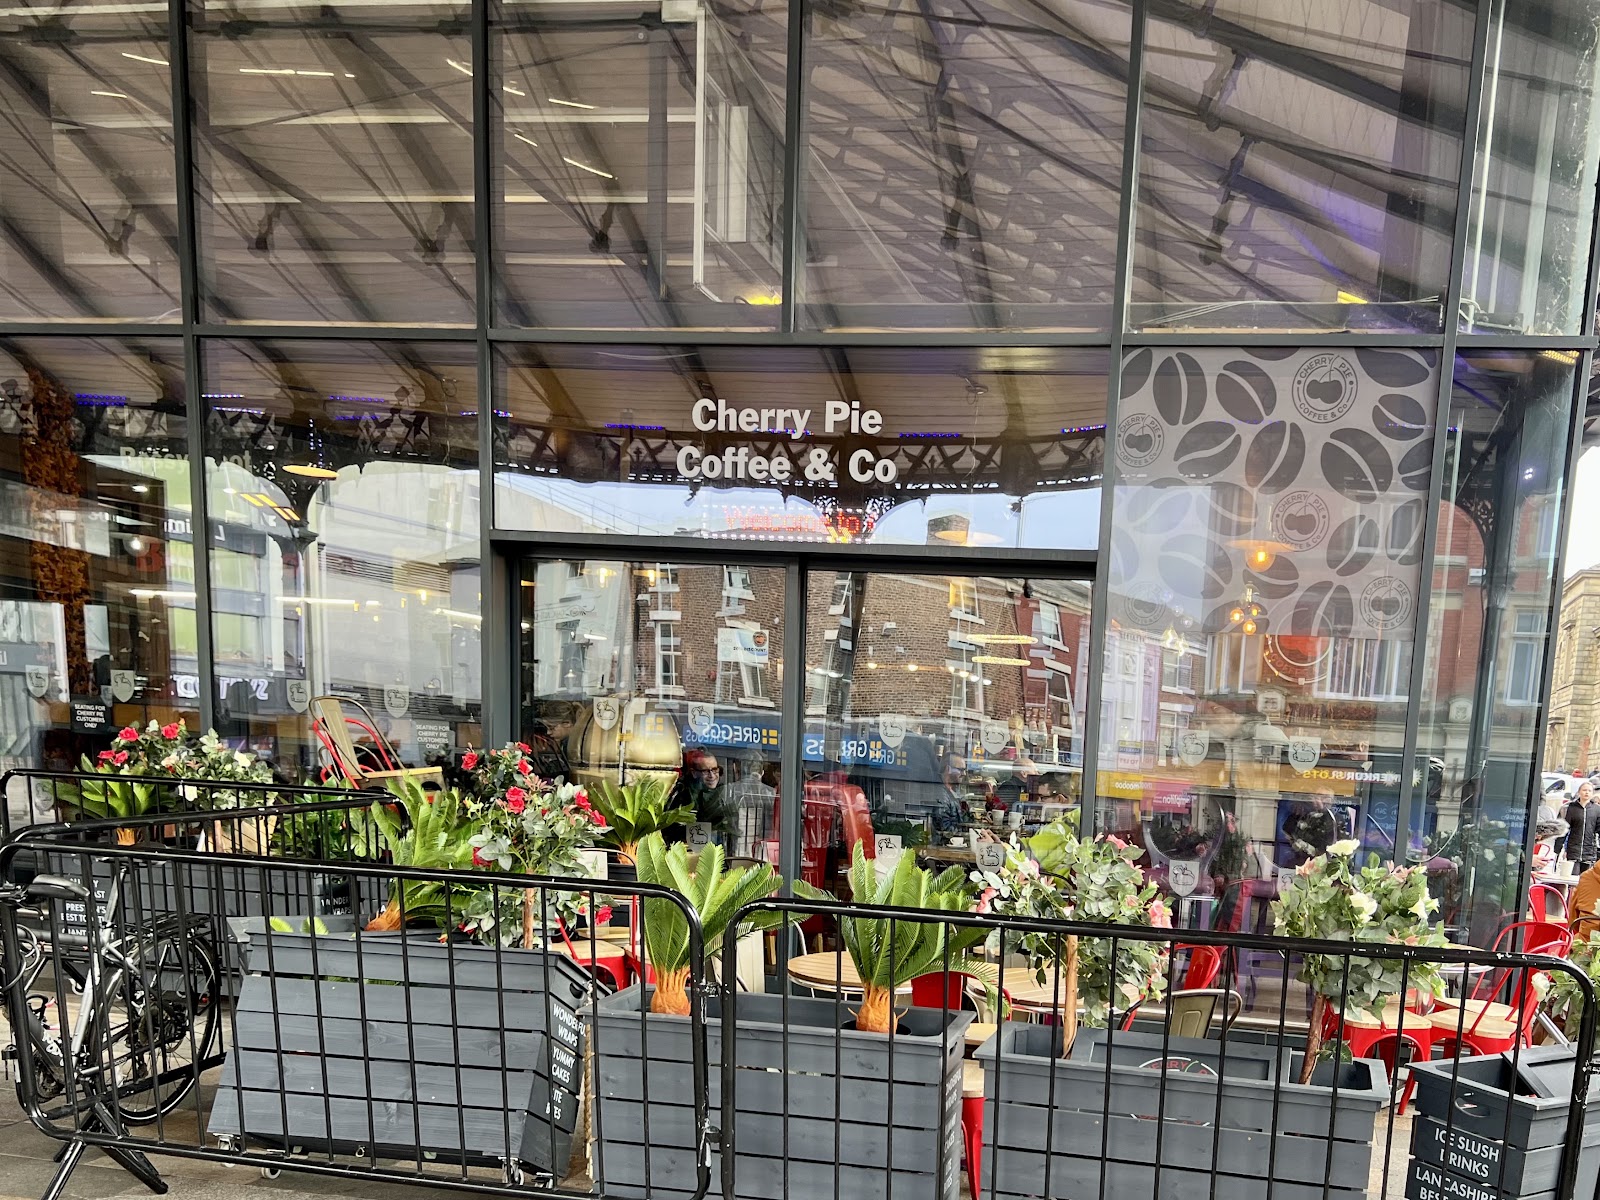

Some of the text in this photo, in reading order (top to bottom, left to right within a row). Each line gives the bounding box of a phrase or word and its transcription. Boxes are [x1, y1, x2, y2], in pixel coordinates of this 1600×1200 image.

[1299, 357, 1353, 379] CHERRY PIE
[691, 398, 883, 440] Cherry Pie
[1299, 402, 1329, 421] COFFEE
[1330, 411, 1337, 419] &
[1119, 416, 1161, 434] CHERRY PIE
[676, 445, 897, 483] Coffee & Co
[1119, 451, 1143, 466] COFFEE
[1277, 493, 1326, 514] CHERRY PIE
[722, 505, 860, 535] Welcome to
[1365, 578, 1408, 597] CHERRY PIE
[76, 715, 106, 723] CUSTOMERS
[558, 1024, 578, 1048] WRAPS
[552, 1045, 576, 1070] YUMMY
[551, 1063, 571, 1084] CAKES
[552, 1087, 562, 1104] ITE
[545, 1101, 562, 1121] BTES
[1434, 1127, 1500, 1163] ICE SLUSH
